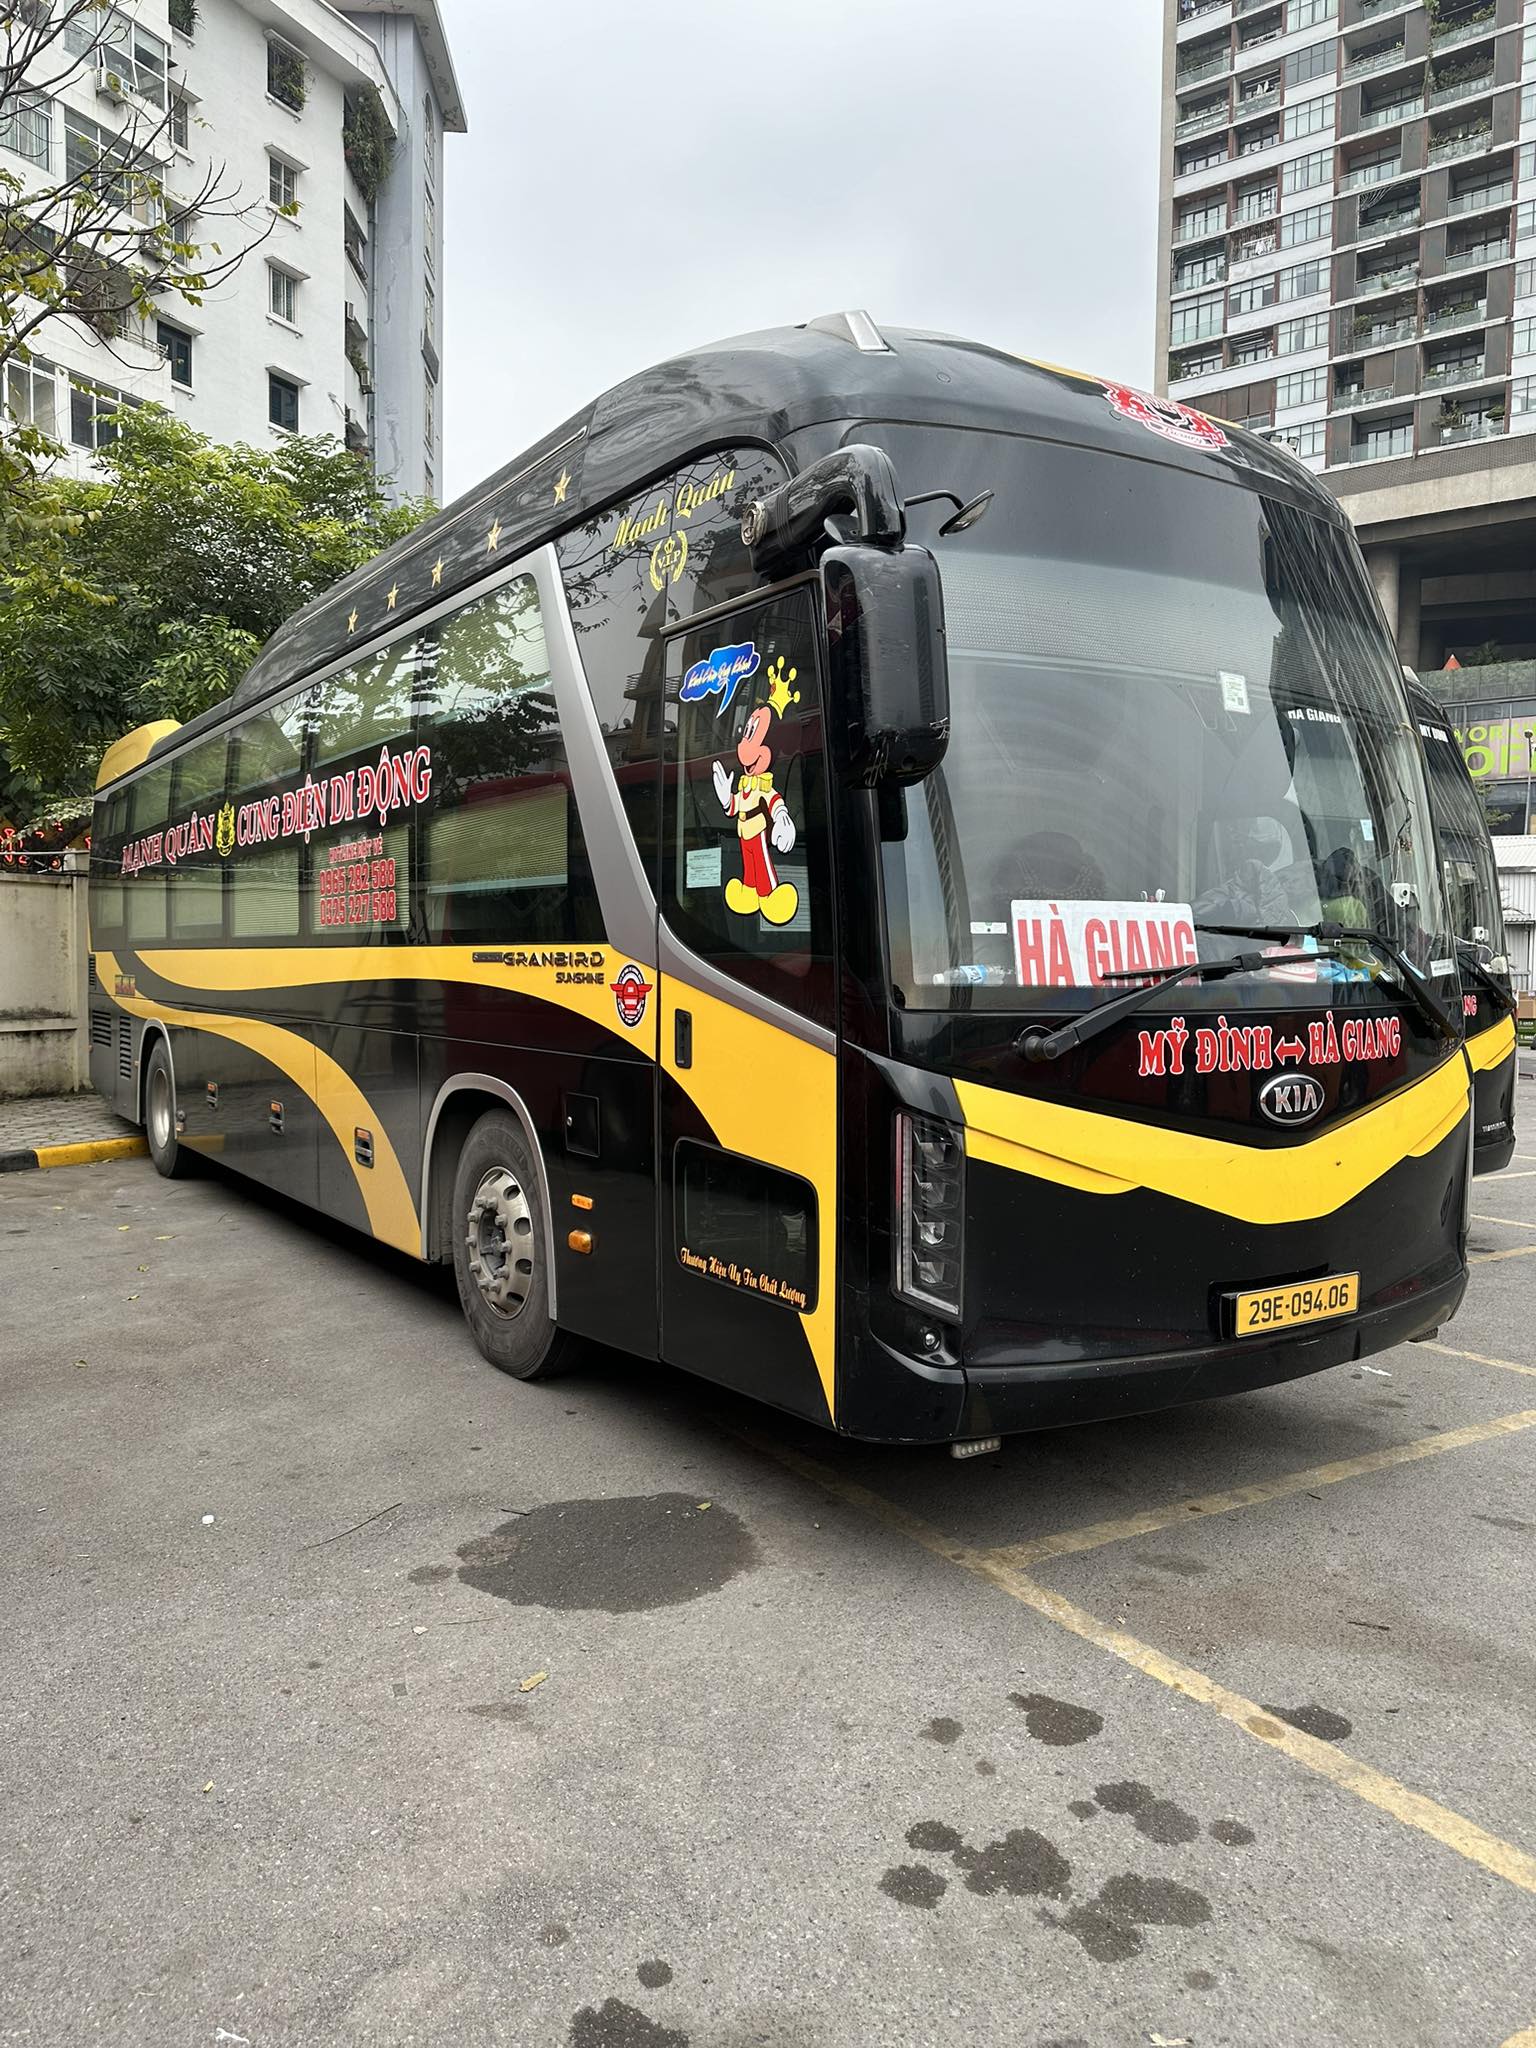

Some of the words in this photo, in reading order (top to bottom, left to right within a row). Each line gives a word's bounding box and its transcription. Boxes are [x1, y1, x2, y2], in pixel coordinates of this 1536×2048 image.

[675, 470, 735, 519] Quân
[121, 832, 163, 878] MẠNH
[164, 811, 215, 865] QUÂN
[236, 796, 280, 847] CUNG
[282, 773, 328, 844] ĐIỆN
[329, 771, 355, 825] DI
[357, 745, 432, 827] ĐỘNG
[348, 862, 369, 893] 282
[371, 857, 396, 889] 588
[348, 892, 370, 924] 227
[372, 889, 396, 922] 588
[502, 951, 604, 968] GRANBIRD
[1017, 903, 1076, 986] HÀ
[1085, 918, 1201, 986] GIANG
[555, 972, 604, 985] SUNSHINE
[1138, 1016, 1189, 1076] MỸ
[1195, 1015, 1273, 1073] ĐÌNH
[1308, 1010, 1341, 1065] HÀ
[1342, 1016, 1401, 1062] GIANG
[1273, 1084, 1318, 1114] KIA
[1249, 1283, 1349, 1326] 29E-094.06
